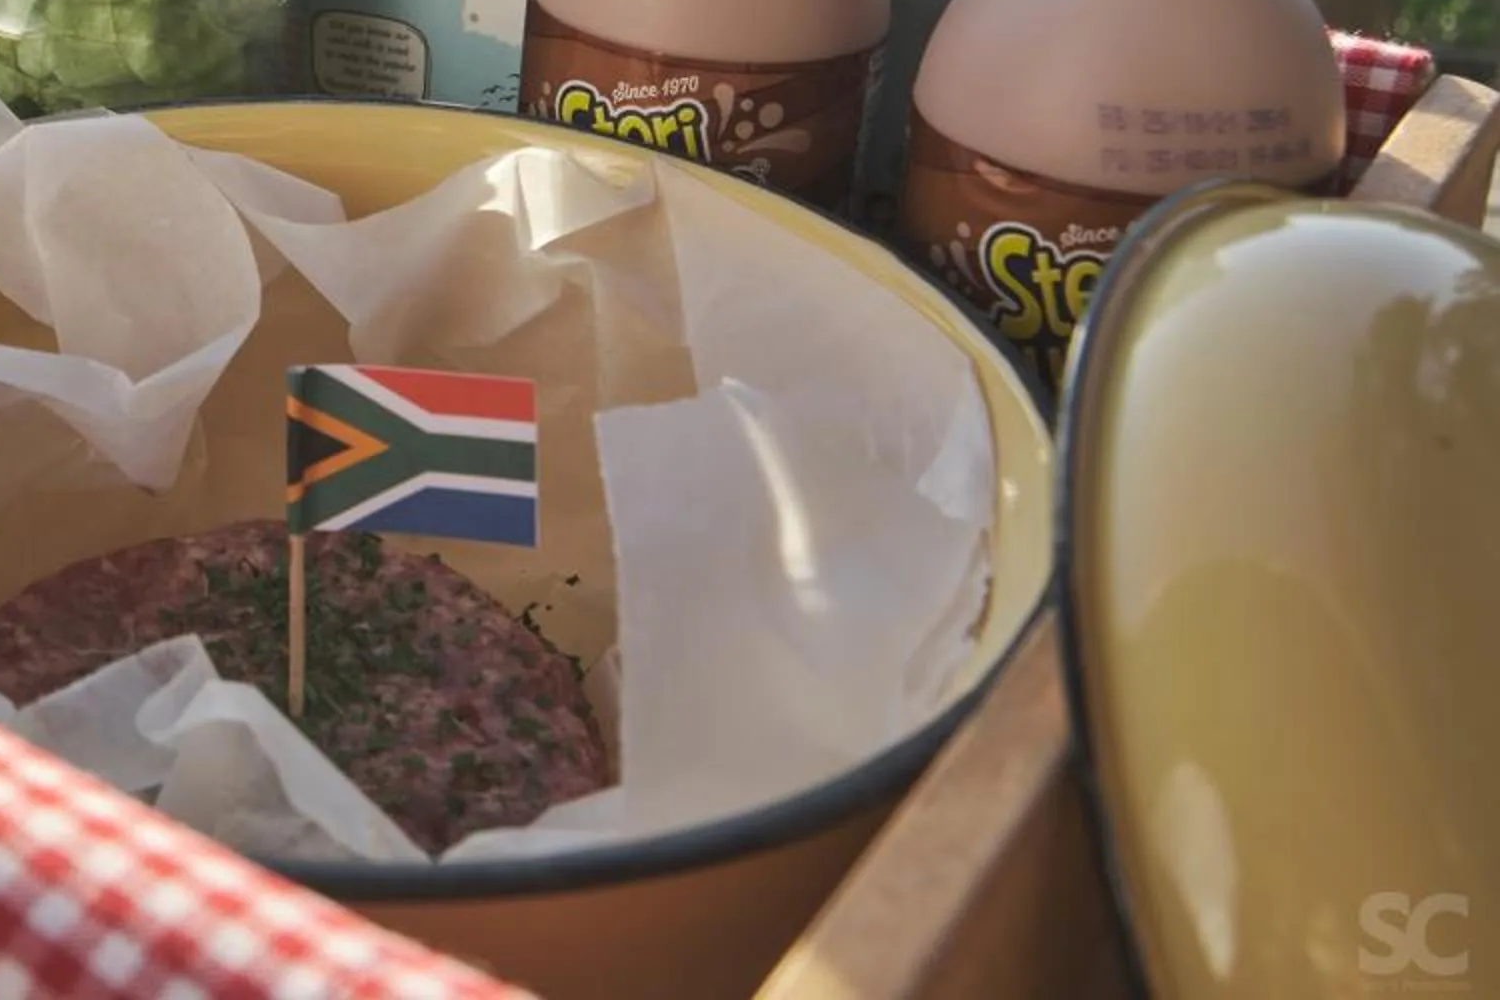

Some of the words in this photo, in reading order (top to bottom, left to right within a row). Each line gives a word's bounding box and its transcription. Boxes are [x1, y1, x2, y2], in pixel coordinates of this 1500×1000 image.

[612, 81, 659, 104] Since
[661, 75, 699, 97] 1970
[1059, 223, 1118, 250] Since
